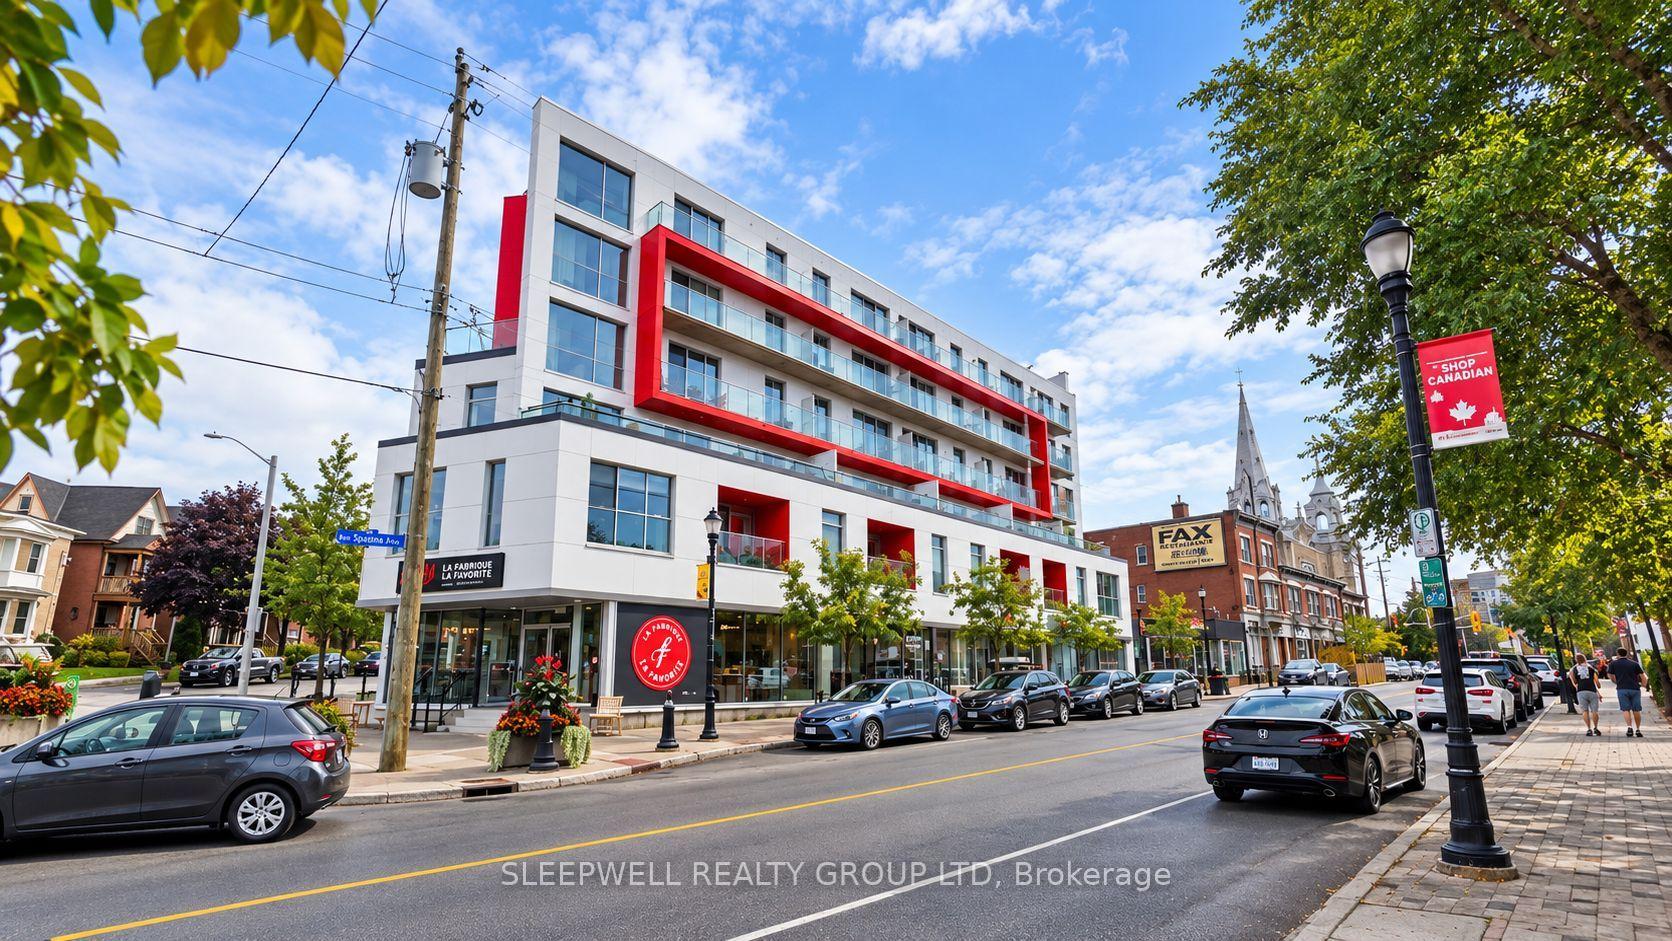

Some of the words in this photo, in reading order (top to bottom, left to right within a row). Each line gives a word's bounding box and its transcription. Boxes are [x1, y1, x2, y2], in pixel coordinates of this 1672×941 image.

[1441, 359, 1476, 373] SHOP
[1427, 366, 1493, 386] CANADIAN
[1158, 524, 1213, 544] FAX
[442, 564, 452, 572] LA
[441, 572, 452, 580] LA
[642, 629, 652, 641] LA
